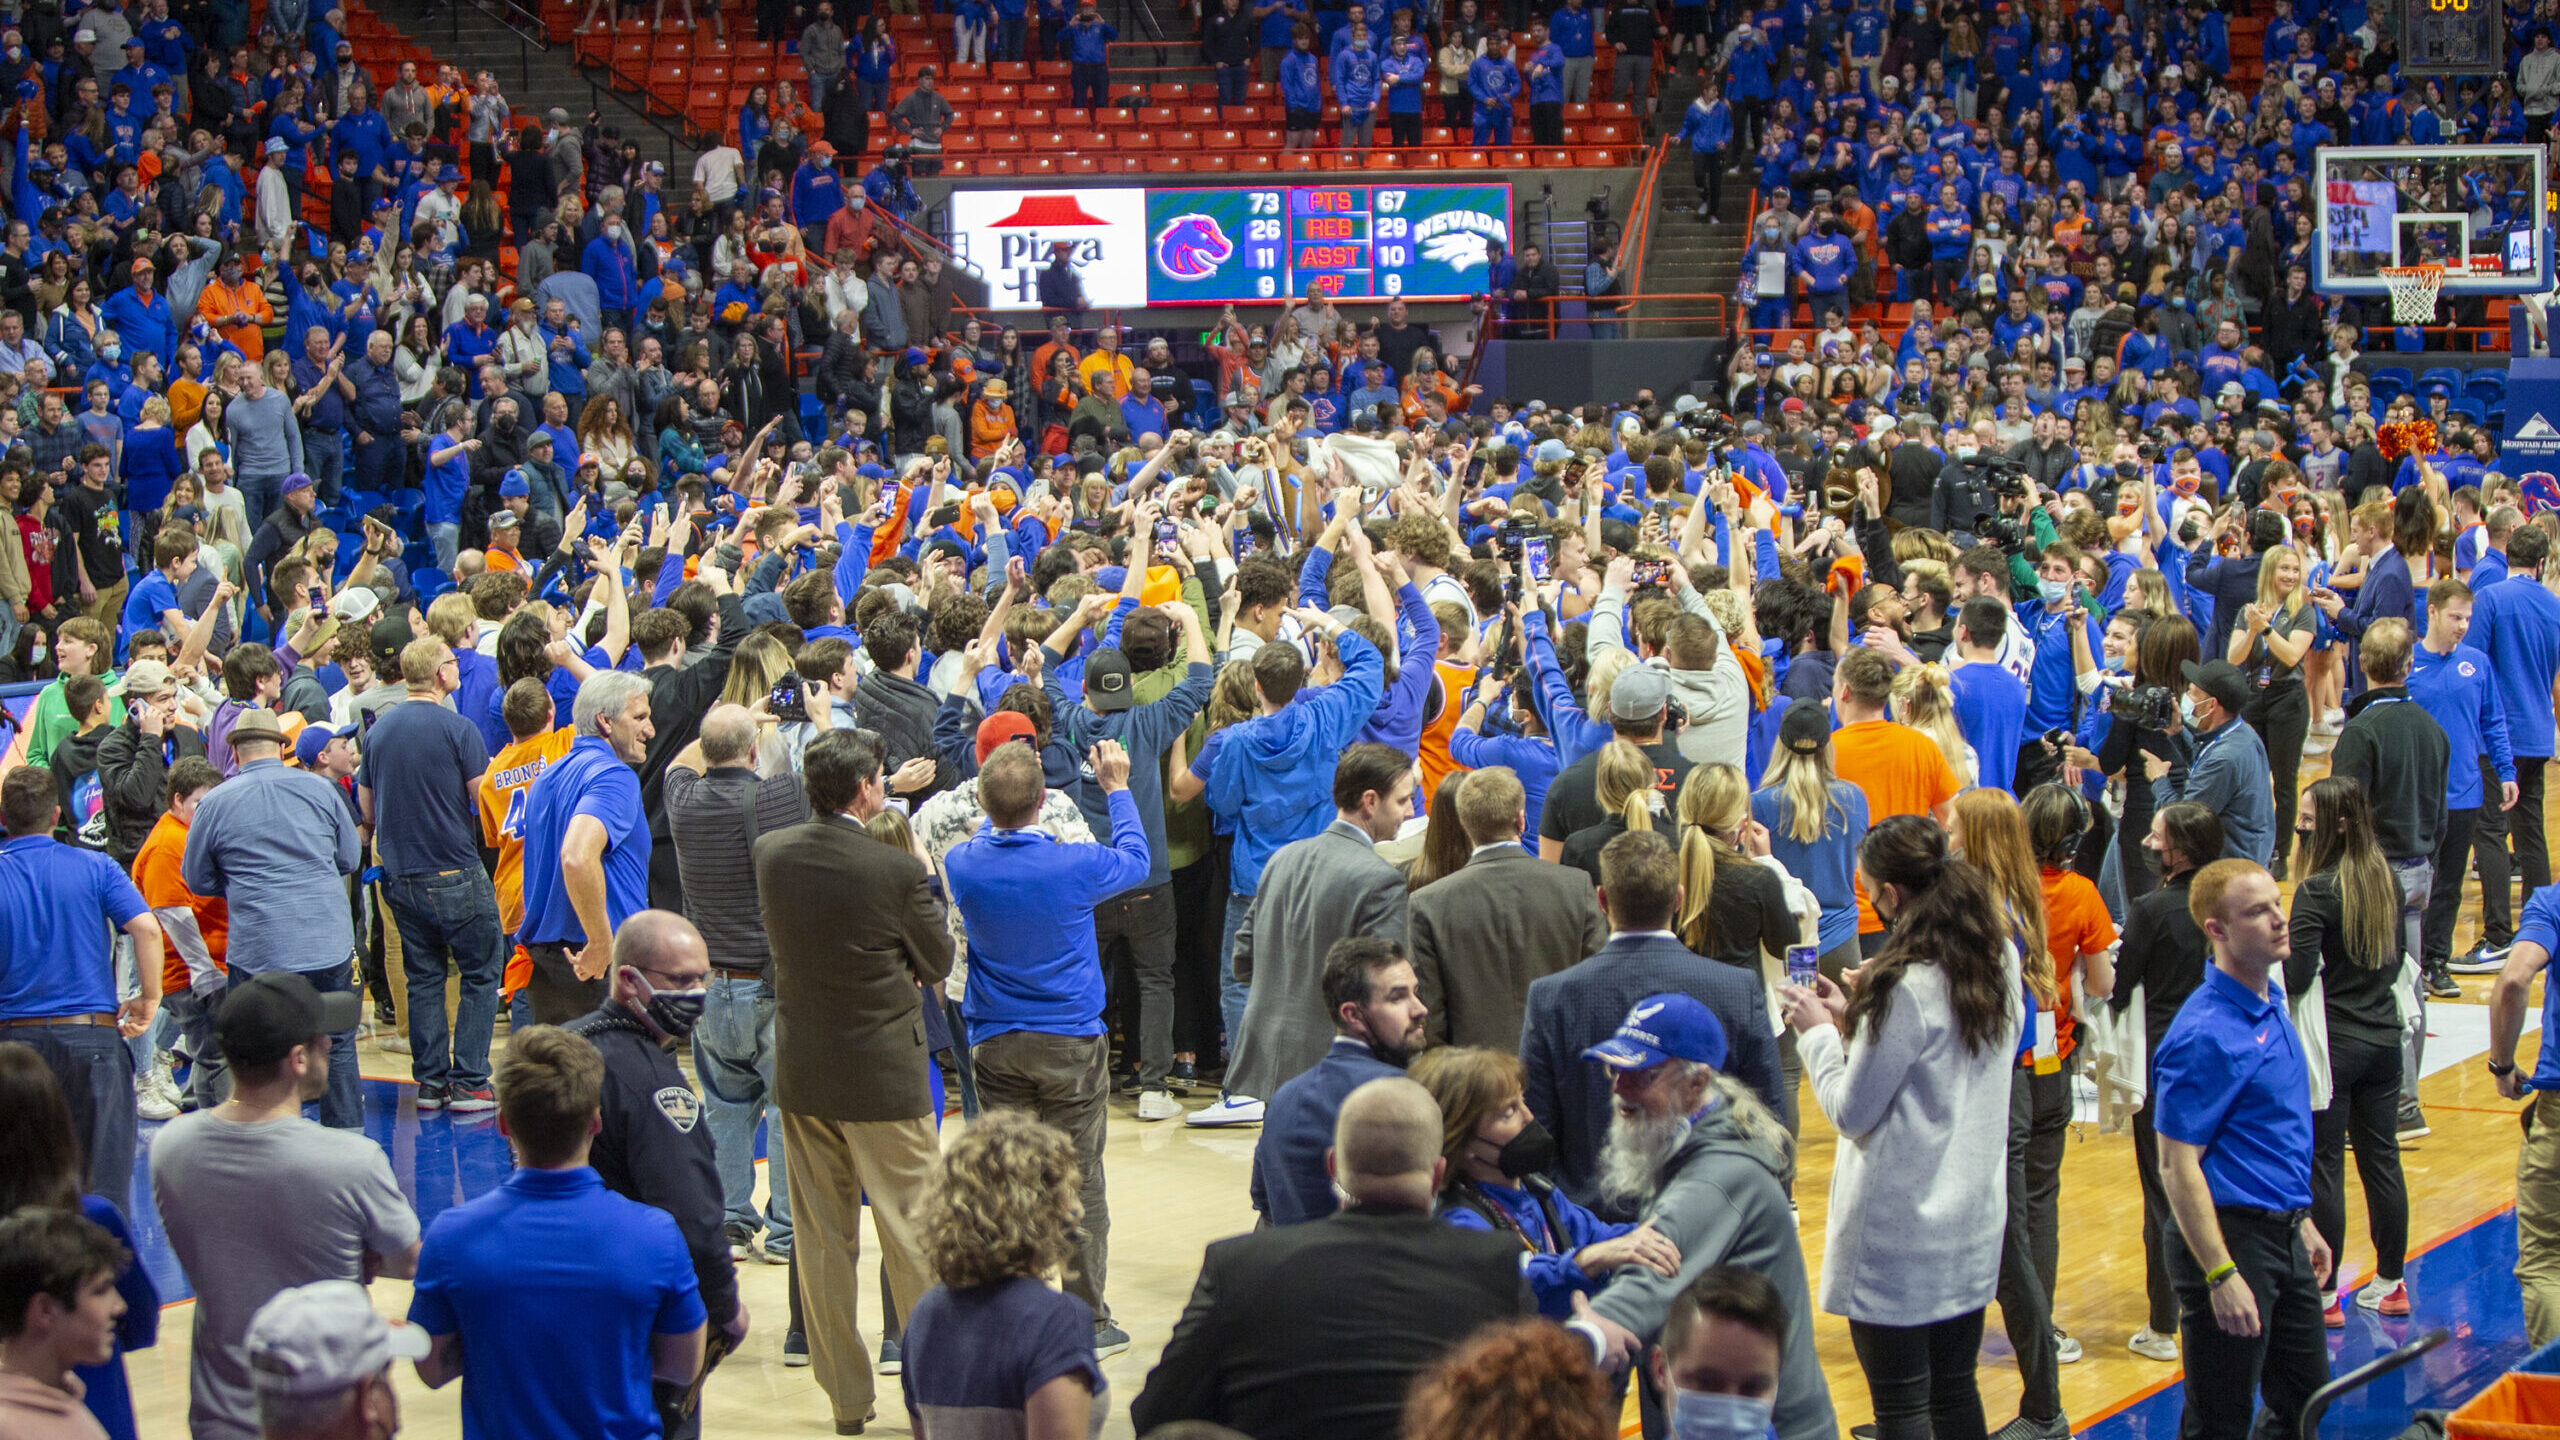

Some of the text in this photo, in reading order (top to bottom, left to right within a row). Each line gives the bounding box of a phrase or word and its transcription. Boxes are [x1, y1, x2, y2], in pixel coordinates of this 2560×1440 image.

[1250, 191, 1406, 214] 73 PTS 67
[1251, 217, 1407, 240] 26 REB 29
[1414, 210, 1507, 243] NEVADA
[1257, 246, 1405, 269] 11 ASST 10
[1257, 276, 1275, 297] 9
[1384, 274, 1402, 296] 9
